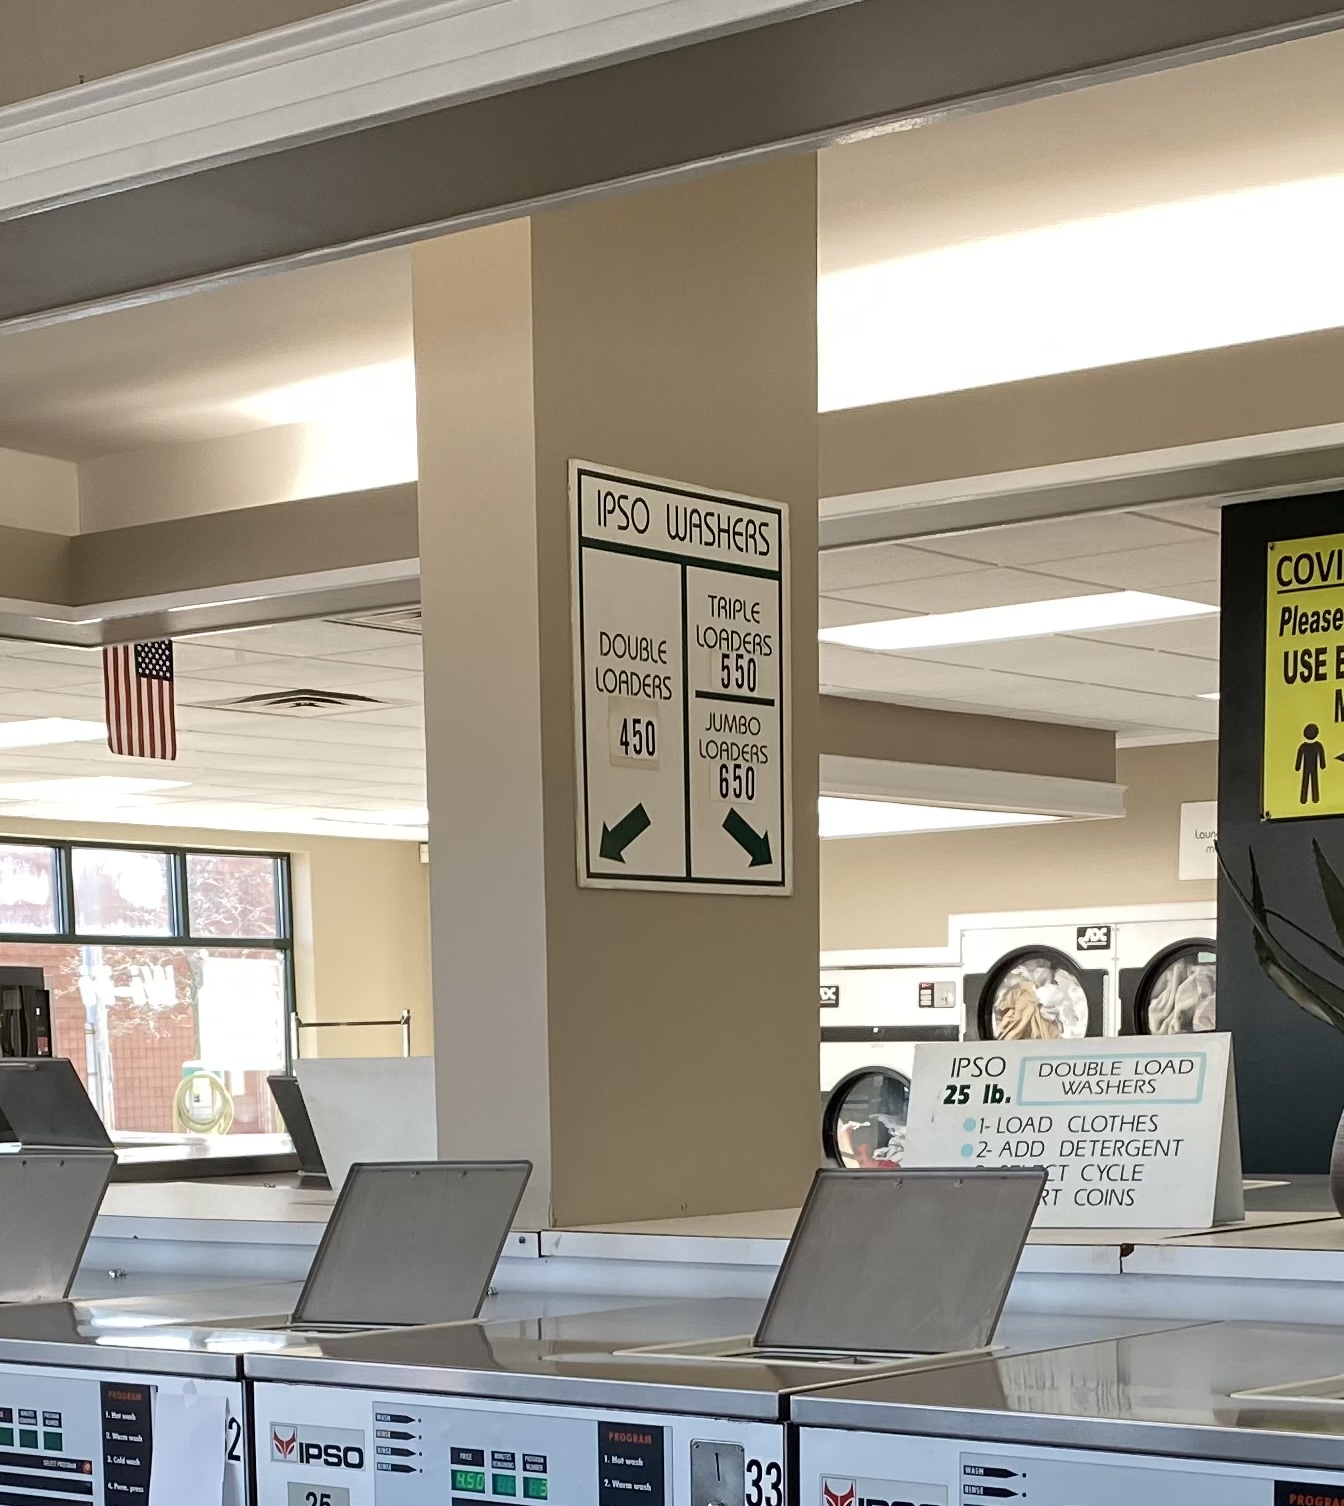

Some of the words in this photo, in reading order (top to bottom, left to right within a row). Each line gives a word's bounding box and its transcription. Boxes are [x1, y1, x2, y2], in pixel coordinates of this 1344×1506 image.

[597, 489, 650, 534] IPSO
[666, 503, 770, 556] WASHERS
[708, 594, 760, 625] TRIPLE
[1279, 606, 1344, 637] Please
[599, 631, 668, 665] DOUBLE
[696, 624, 772, 658] LOADERS
[721, 653, 757, 693] 550
[1283, 647, 1328, 684] USE
[595, 666, 672, 701] LOADERS
[620, 717, 655, 757] 450
[705, 712, 761, 736] JUMBO
[699, 739, 768, 765] LOADERS
[719, 763, 754, 801] 650
[950, 1056, 1006, 1079] IPSO
[1038, 1060, 1123, 1079] DOUBLE
[1133, 1059, 1194, 1075] LOAD
[943, 1084, 970, 1105] 25
[983, 1084, 1011, 1105] lb.
[1061, 1079, 1156, 1096] WASHERS
[996, 1116, 1053, 1134] LOAD
[1067, 1114, 1159, 1133] CLOTHES
[976, 1141, 992, 1158] 2-
[998, 1141, 1045, 1158] ADD
[1059, 1138, 1184, 1157] DETERGENT
[1080, 1164, 1144, 1182] CYCLE
[1073, 1189, 1136, 1206] COINS
[225, 1417, 241, 1461] 2
[299, 1442, 364, 1470] IPSO
